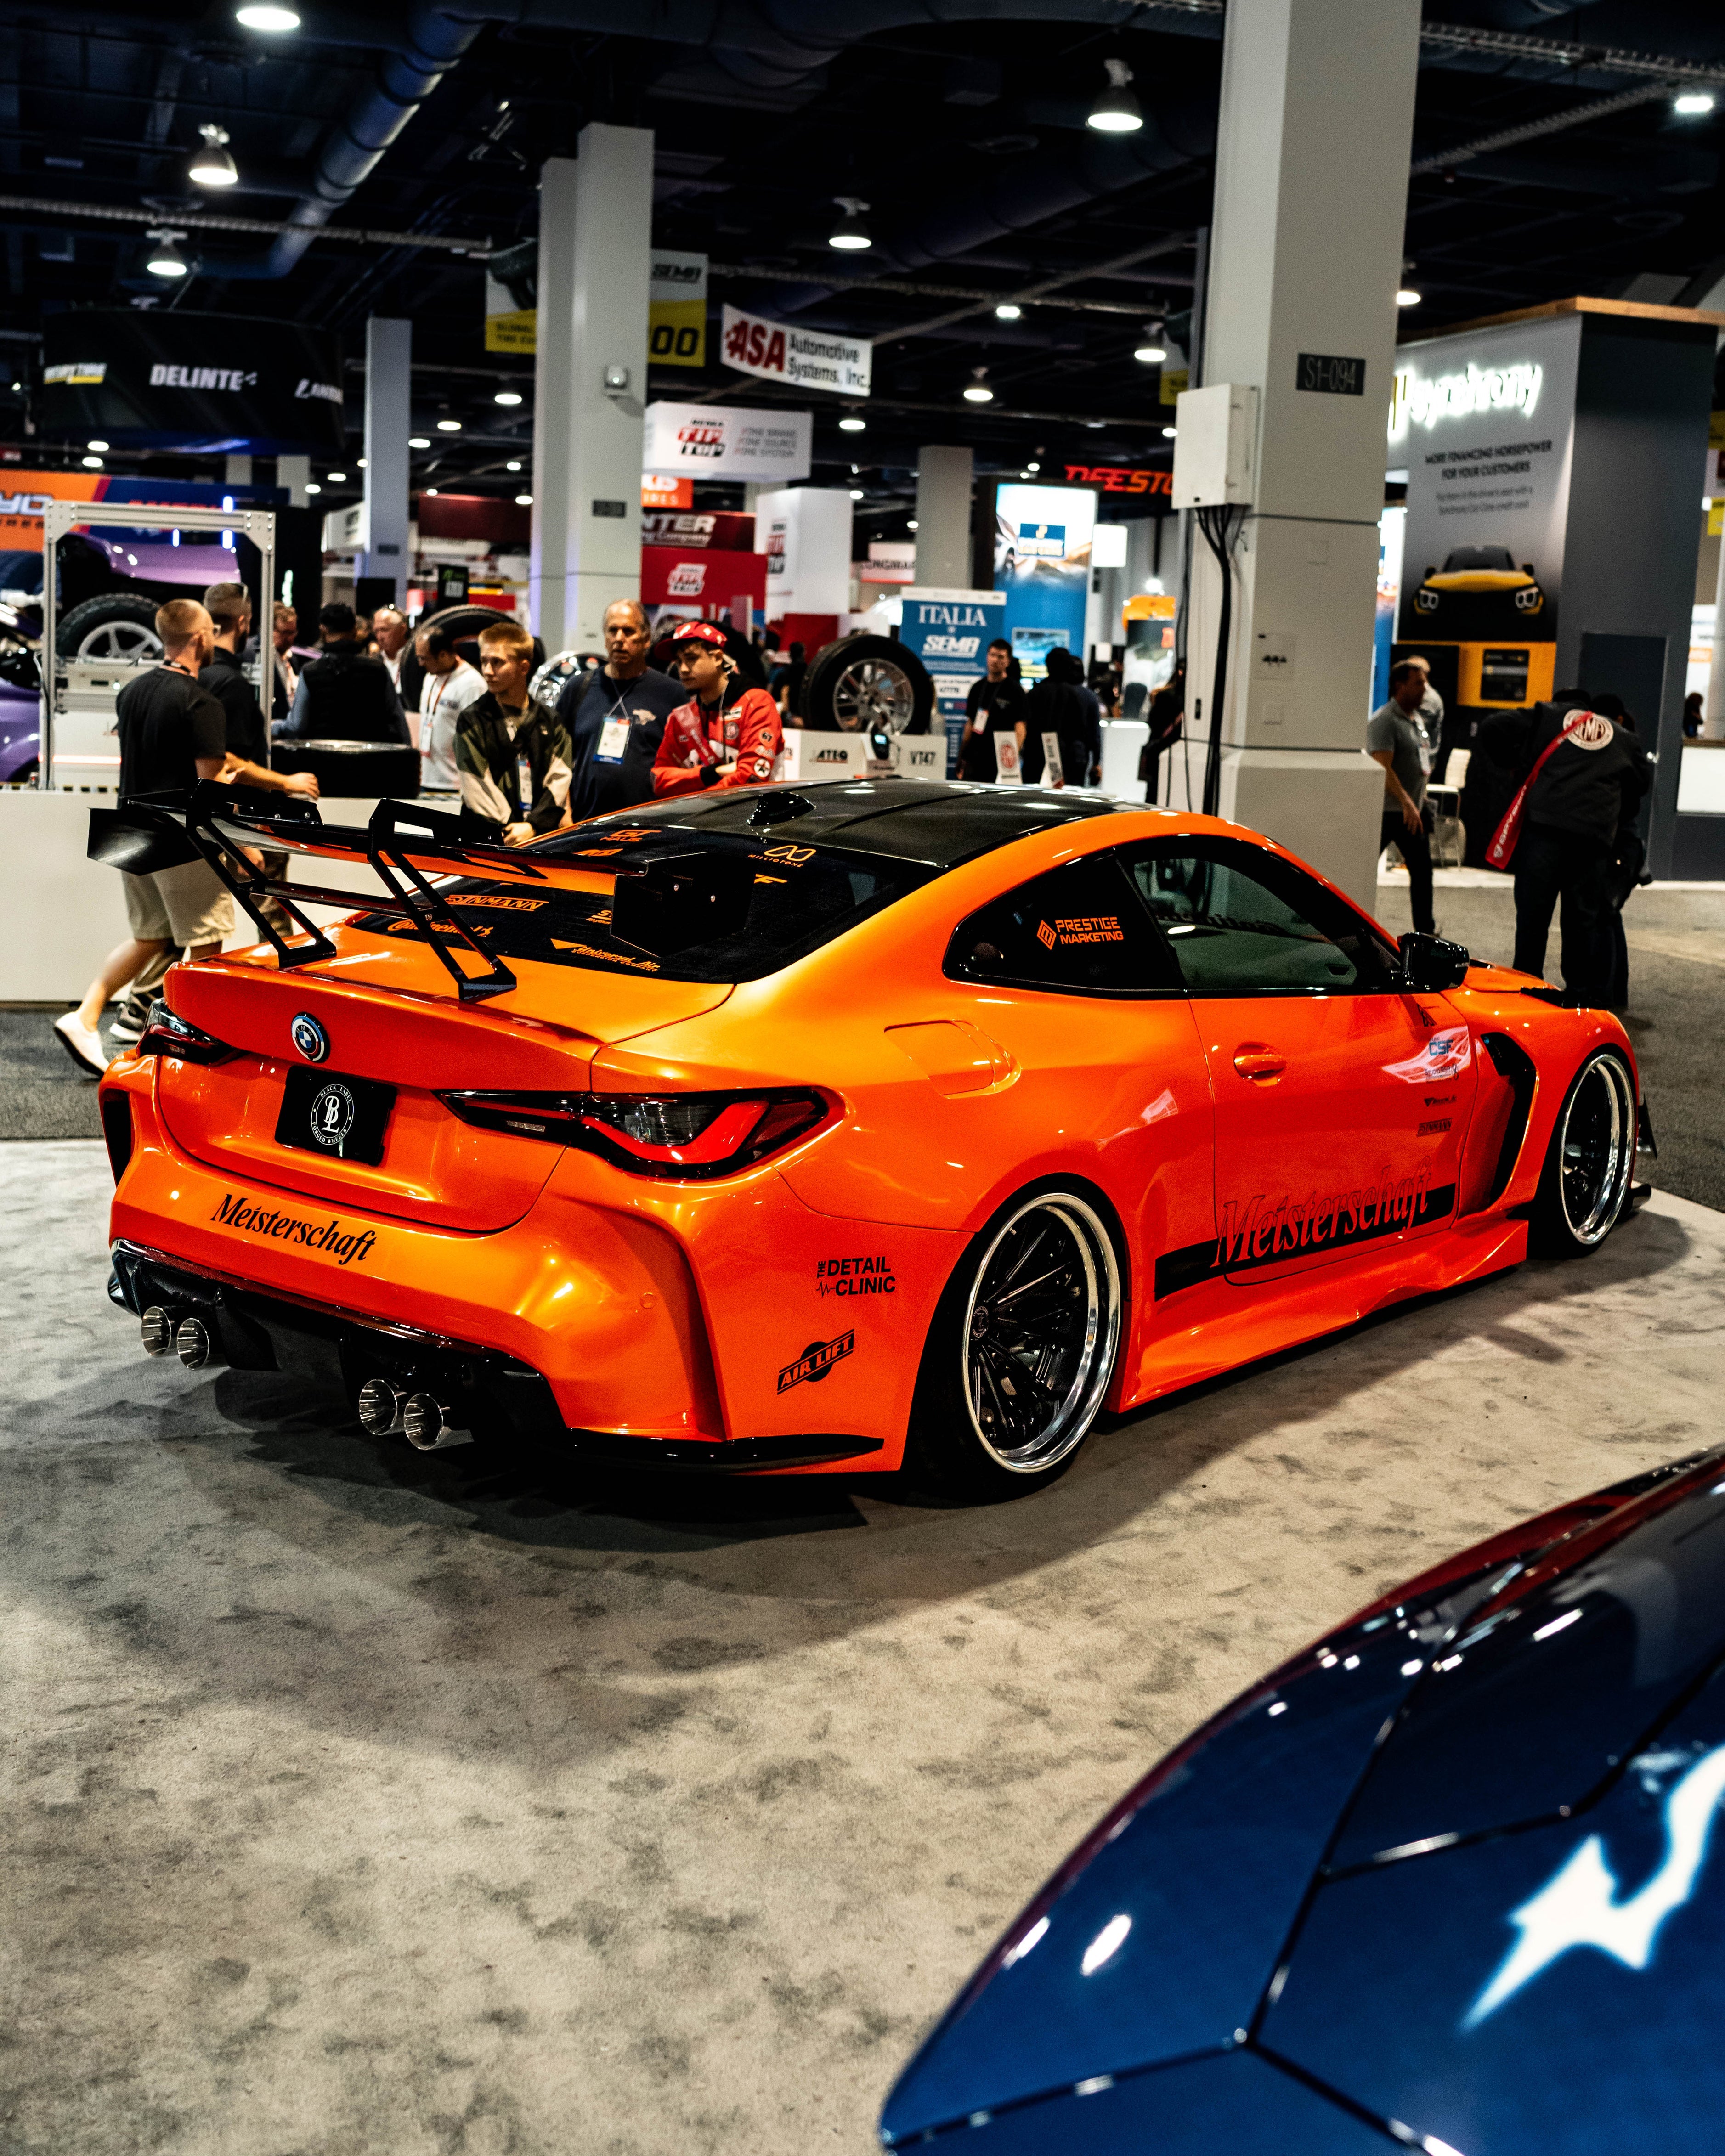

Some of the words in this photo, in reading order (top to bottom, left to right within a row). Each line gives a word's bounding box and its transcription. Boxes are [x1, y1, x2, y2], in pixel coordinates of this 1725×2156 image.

[789, 334, 860, 363] Automotive
[149, 364, 244, 391] DELINTE
[1304, 356, 1357, 393] S1-094
[918, 604, 987, 626] ITALIA
[922, 634, 981, 656] SEMA
[611, 829, 662, 837] GT
[1055, 916, 1120, 933] PRESTIGE
[1059, 931, 1124, 944] MARKETING
[577, 945, 636, 963] Universal
[638, 960, 660, 969] Air
[296, 1025, 313, 1037] BMW
[1429, 1039, 1454, 1056] CSF
[320, 1085, 336, 1098] BLACK
[340, 1087, 351, 1104] LABEL
[312, 1121, 325, 1142] FORGED
[328, 1128, 347, 1144] WHEELS
[1209, 1155, 1433, 1268] Meisterschaft
[210, 1194, 378, 1265] Meisterschaft
[817, 1260, 826, 1279] THE
[827, 1256, 891, 1276] DETAIL
[835, 1276, 896, 1296] CLINIC
[780, 1360, 811, 1388] AIR
[816, 1336, 851, 1368] LIFT
